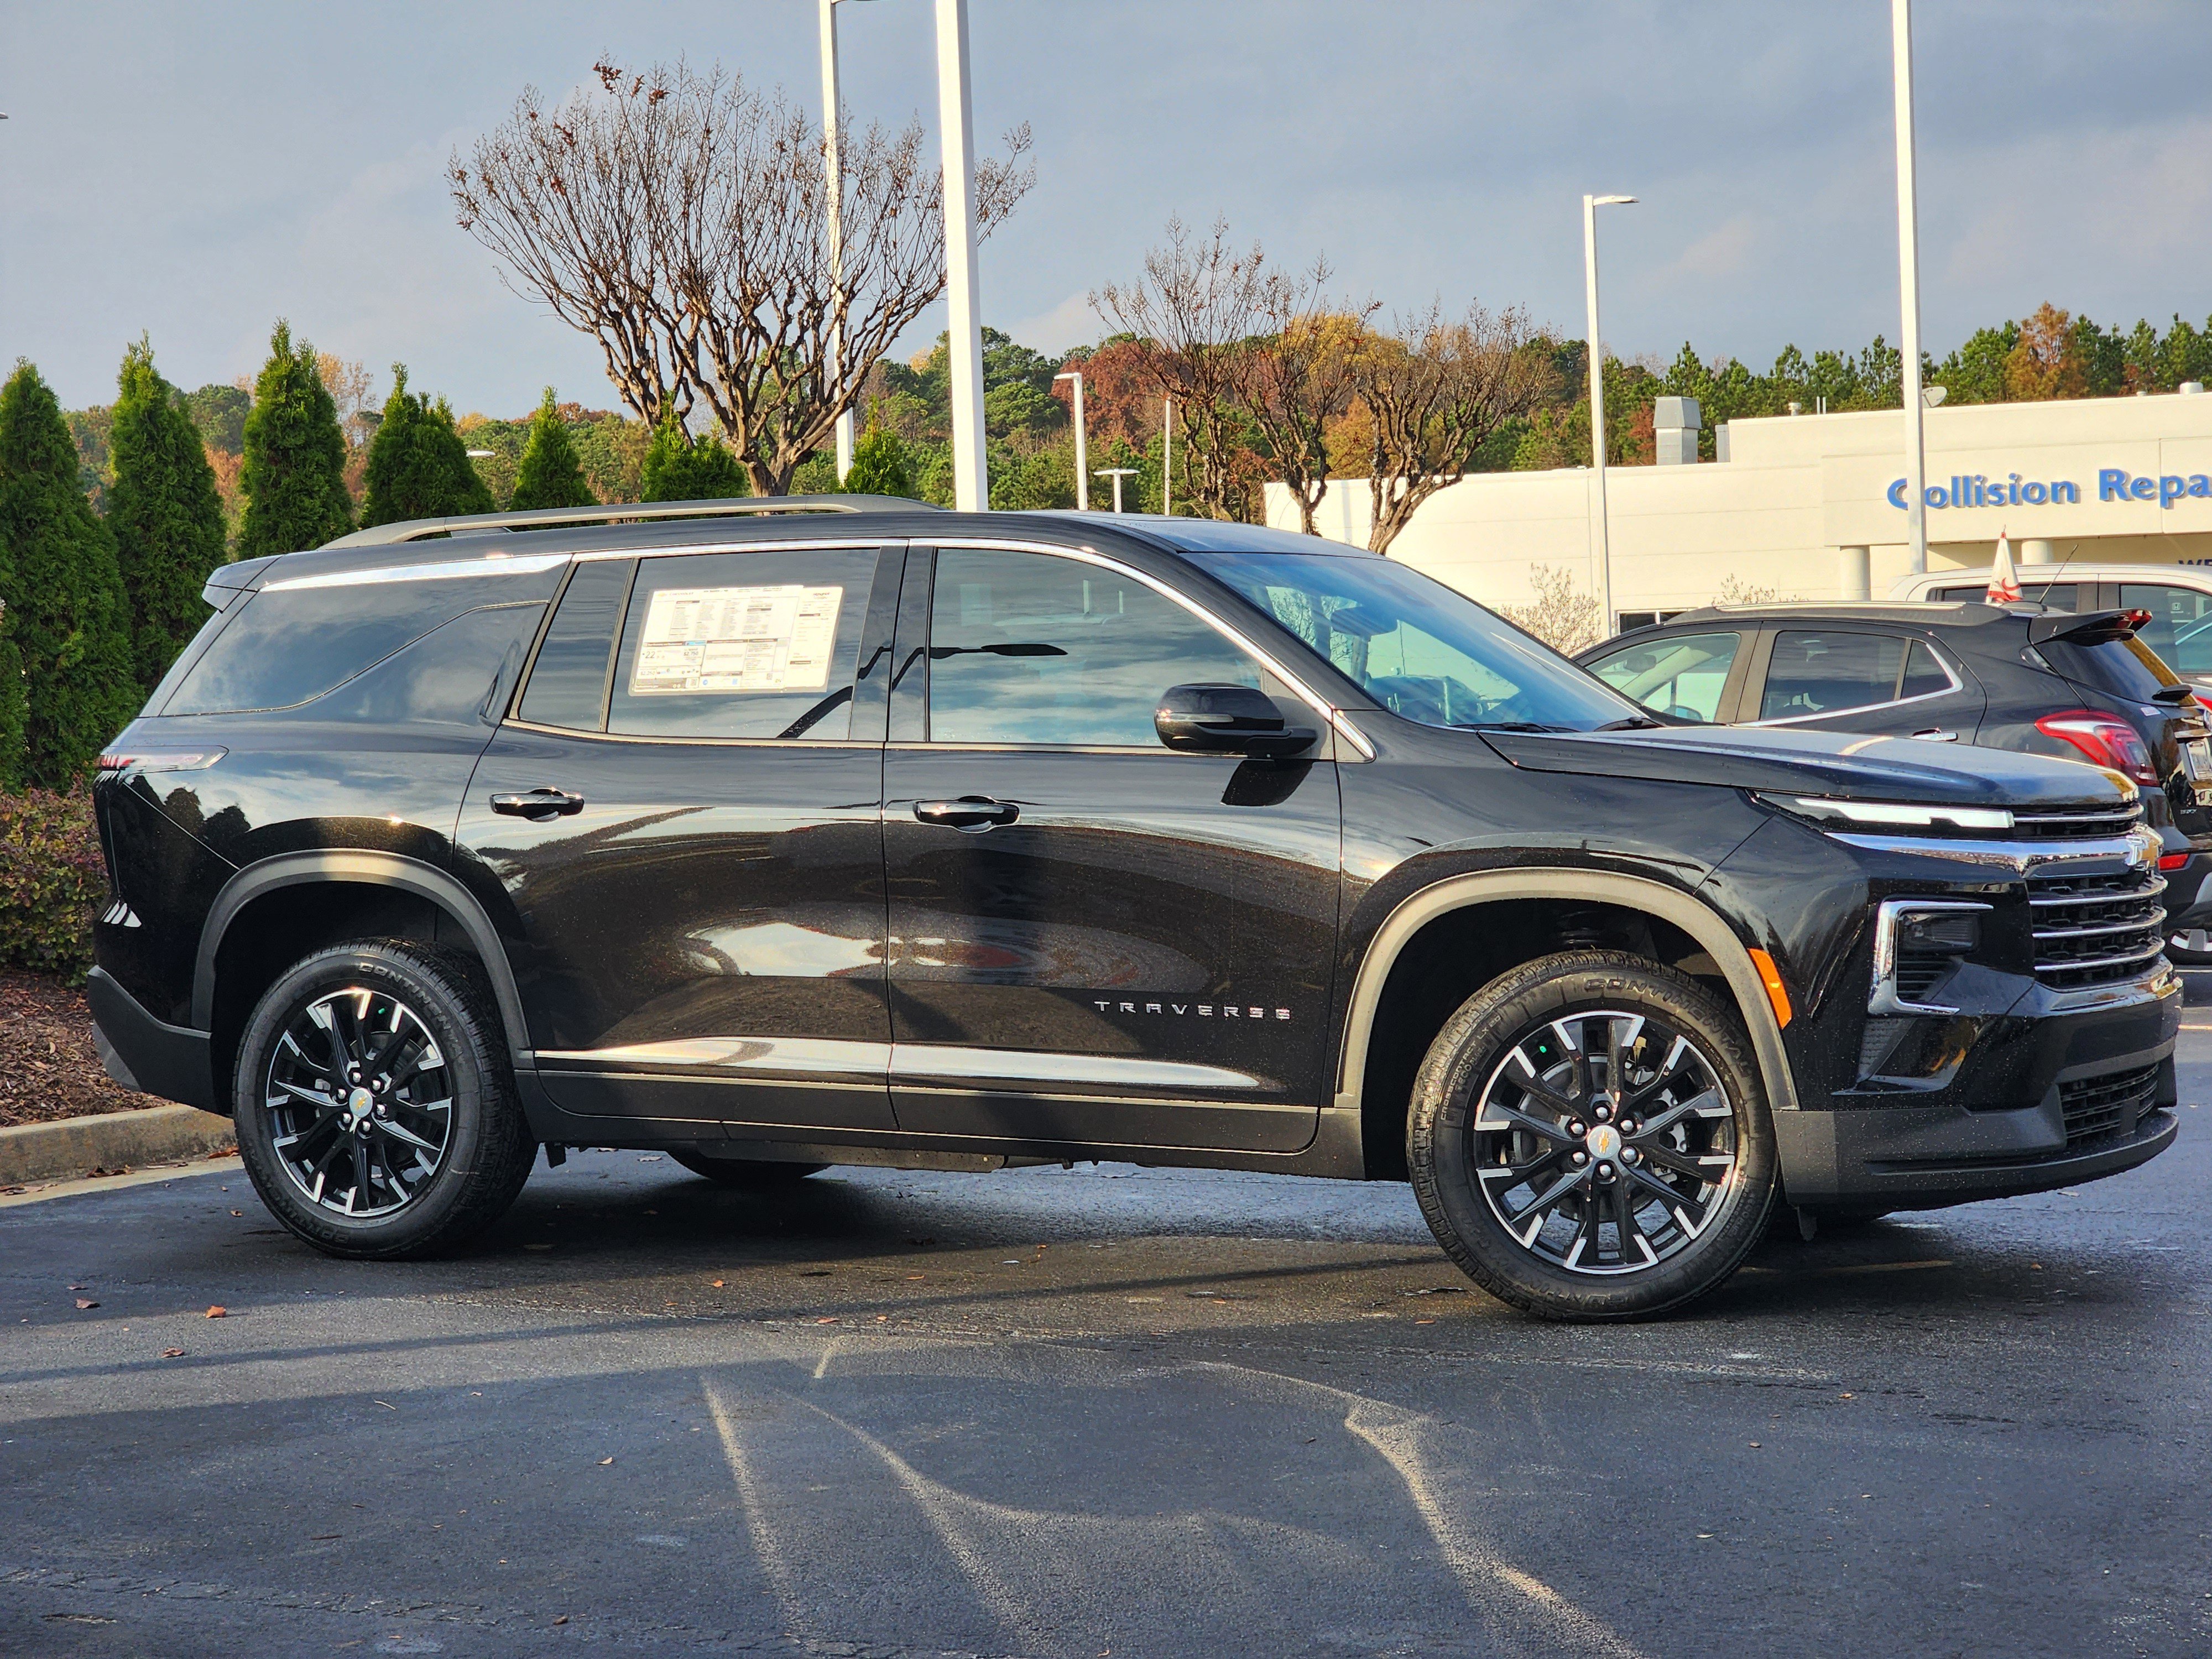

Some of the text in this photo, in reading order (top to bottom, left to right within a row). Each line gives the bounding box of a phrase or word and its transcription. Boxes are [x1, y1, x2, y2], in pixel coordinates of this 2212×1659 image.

[1887, 468, 2212, 510] Collision Repa
[1094, 1001, 1291, 1020] TRAVERSE
